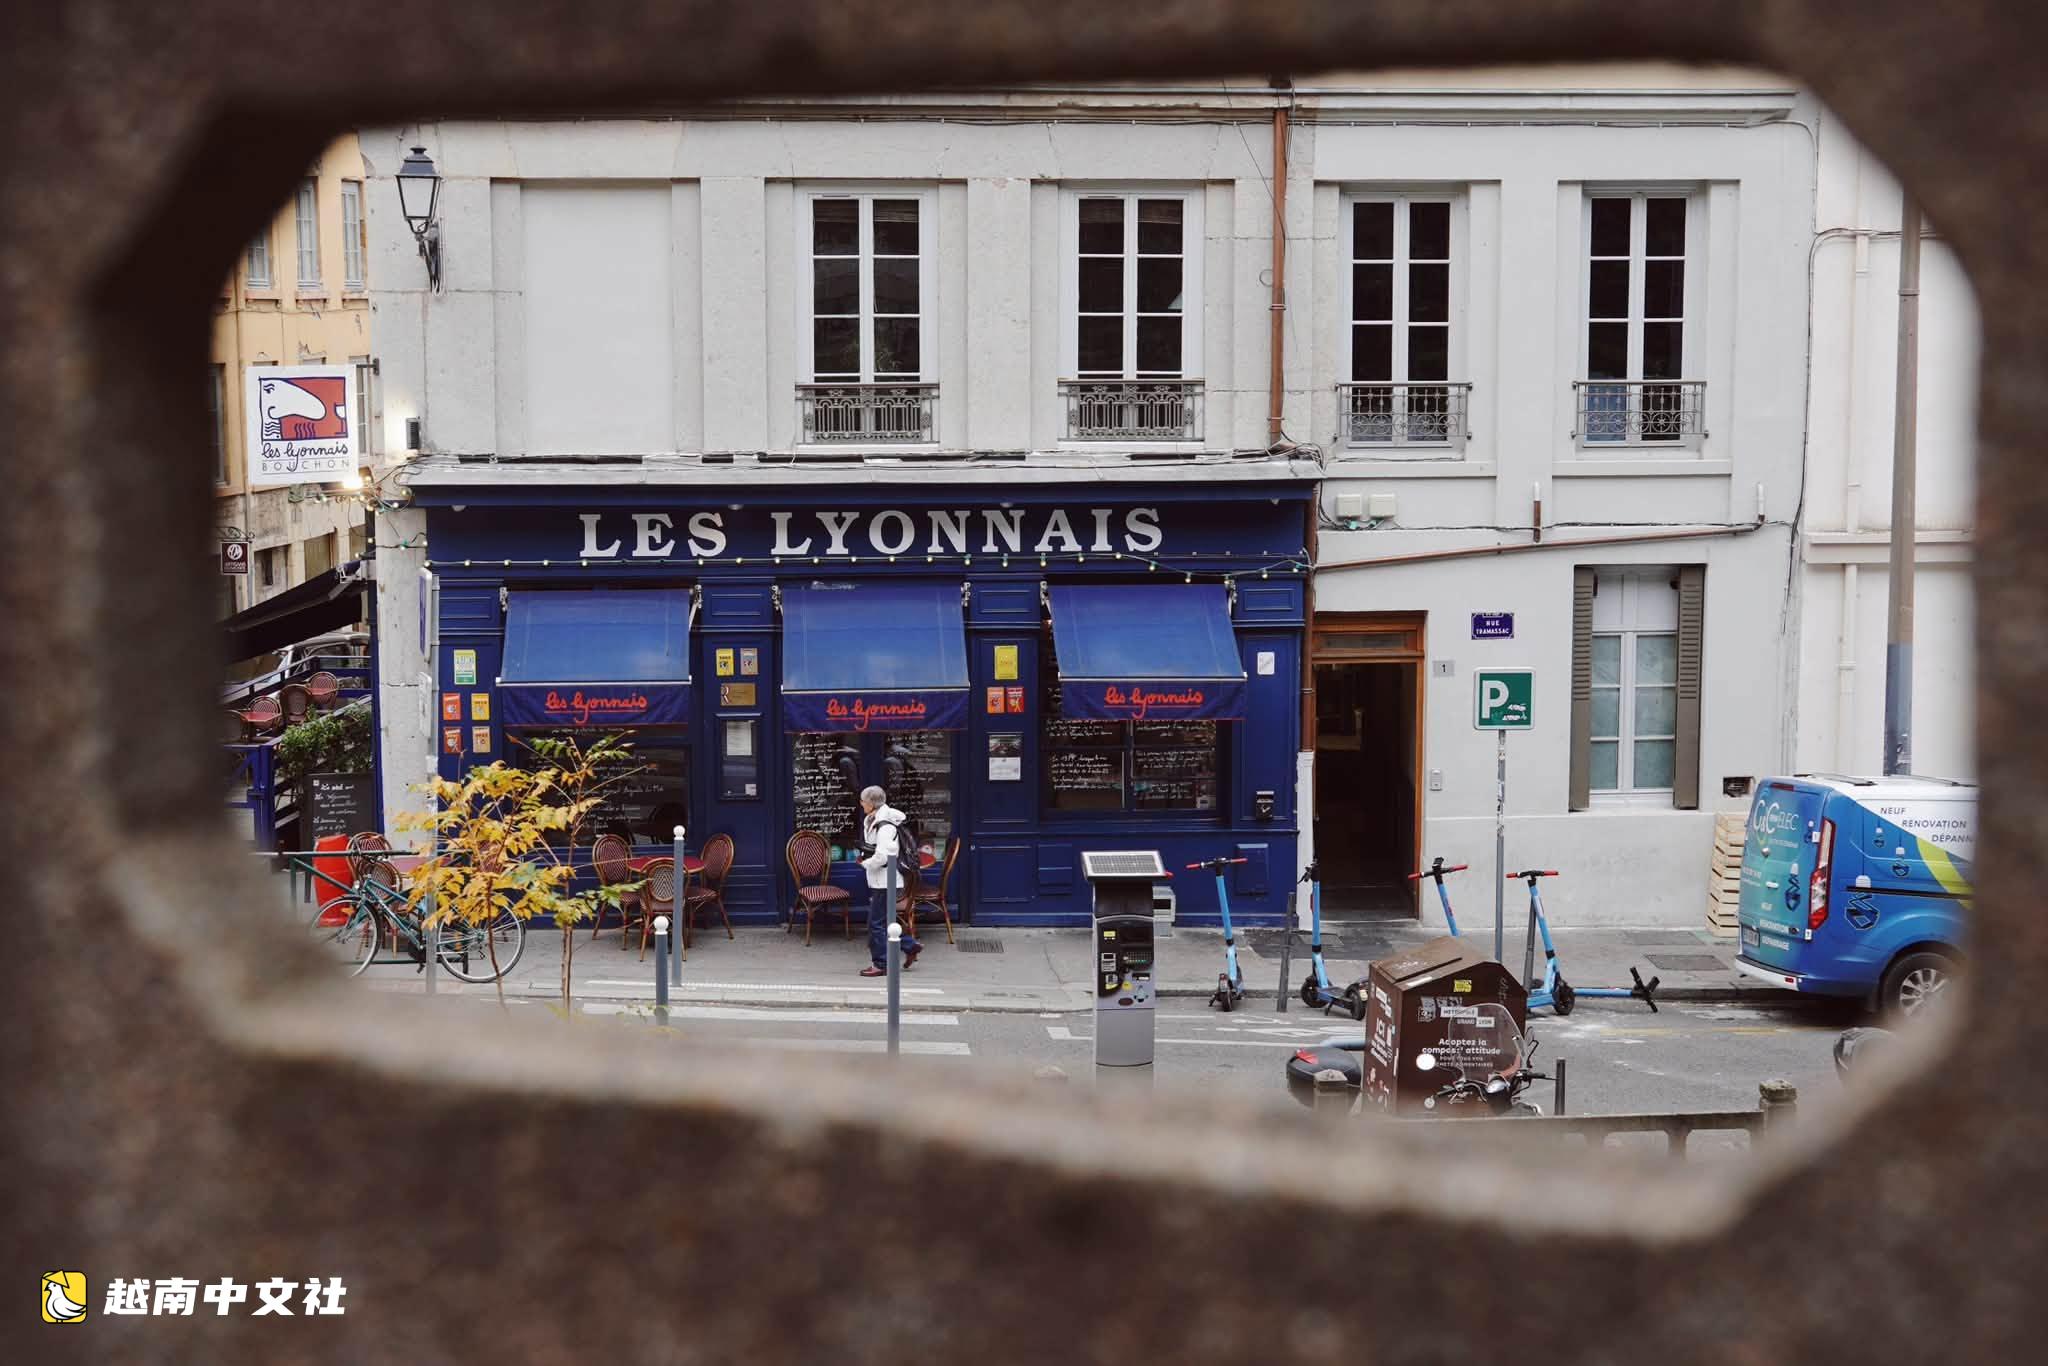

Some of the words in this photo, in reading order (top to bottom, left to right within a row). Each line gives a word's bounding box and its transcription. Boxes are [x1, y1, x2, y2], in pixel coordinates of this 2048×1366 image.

[261, 442, 281, 459] les
[283, 441, 349, 472] lyonnais
[262, 459, 349, 472] BOUCHON
[579, 511, 728, 558] LES
[770, 508, 1164, 555] LYONNAIS
[1485, 619, 1500, 627] RUE
[1442, 664, 1446, 673] 1
[544, 691, 567, 709] les
[572, 691, 648, 724] lyonnais
[1104, 685, 1126, 704] les
[1129, 686, 1204, 719] lyonnais
[1481, 680, 1509, 719] P
[826, 698, 848, 715] les
[852, 698, 927, 731] lyonnais
[1880, 807, 1907, 815] NEUF
[1465, 1046, 1501, 1055] attitude
[1478, 1038, 1487, 1046] la
